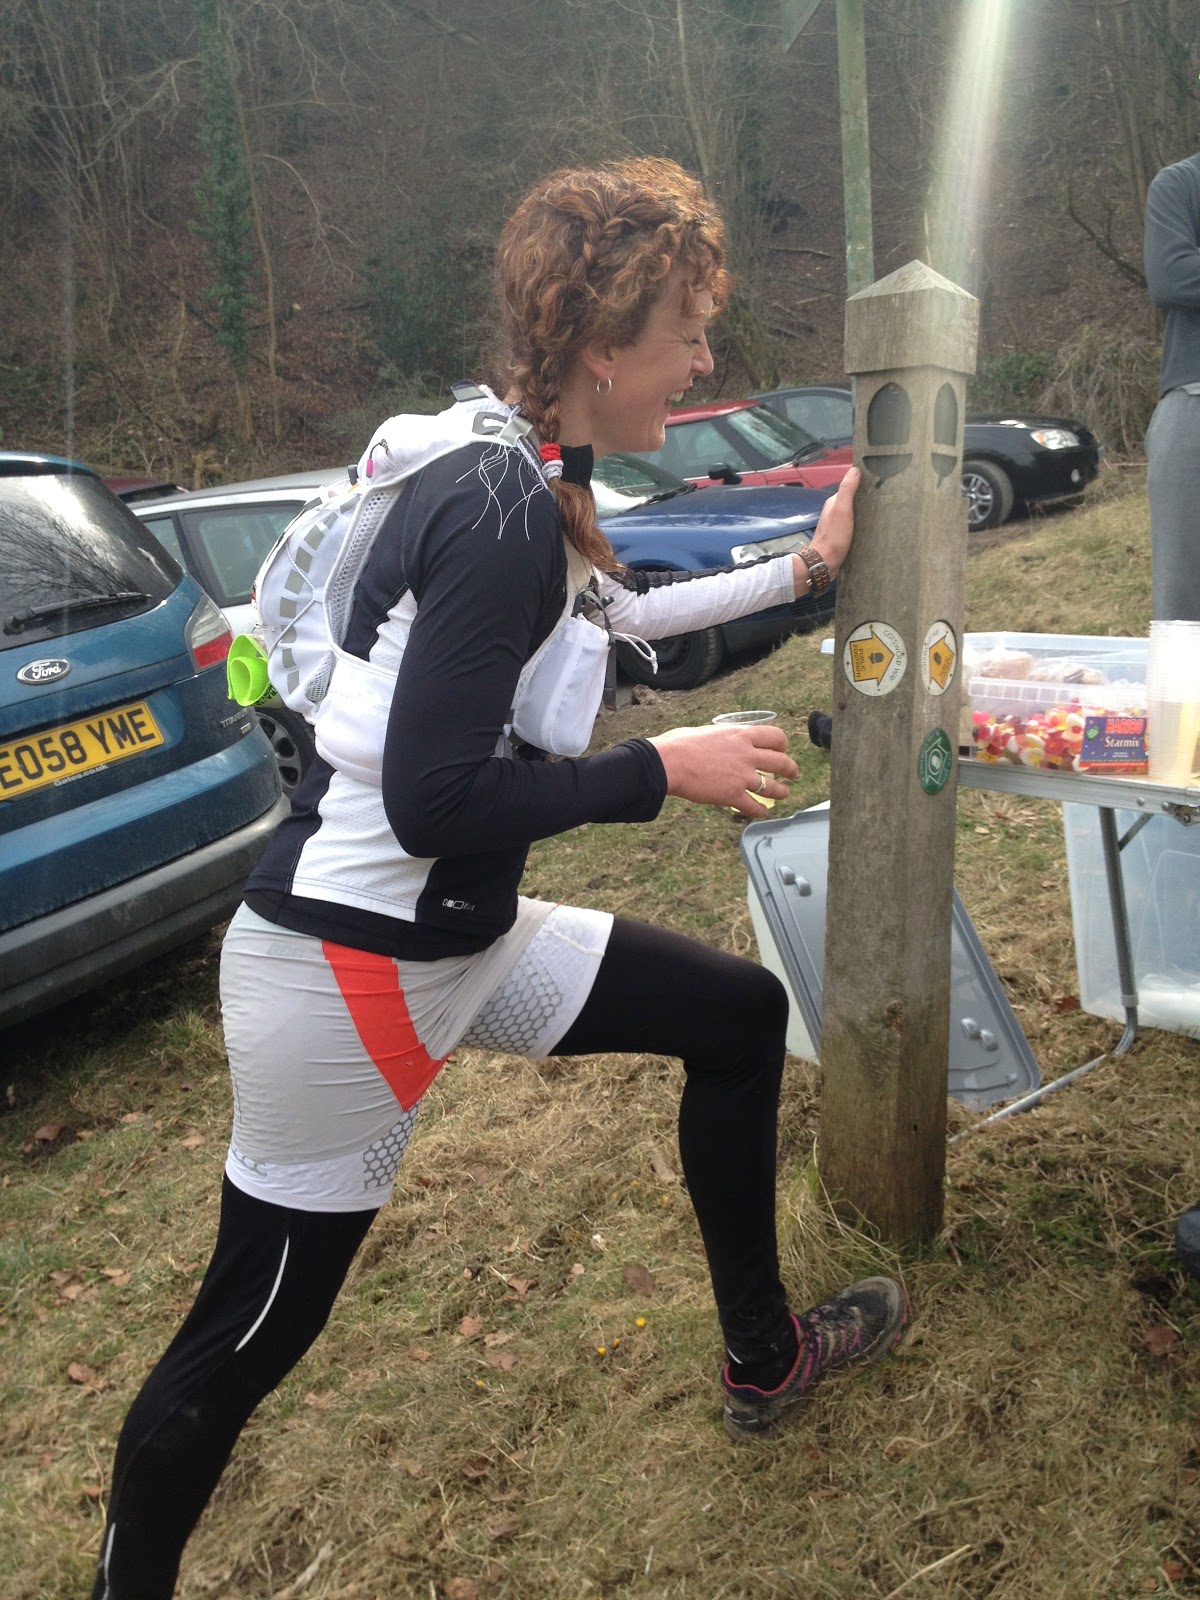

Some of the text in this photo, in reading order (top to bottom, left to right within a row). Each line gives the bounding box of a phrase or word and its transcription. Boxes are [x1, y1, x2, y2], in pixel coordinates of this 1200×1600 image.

[852, 644, 861, 678] FOOTPATH
[883, 629, 902, 682] COTSWOLD WAY
[31, 661, 62, 680] Ford
[86, 708, 156, 755] YME
[1104, 718, 1145, 735] HARIBO
[1104, 736, 1140, 748] Starmix
